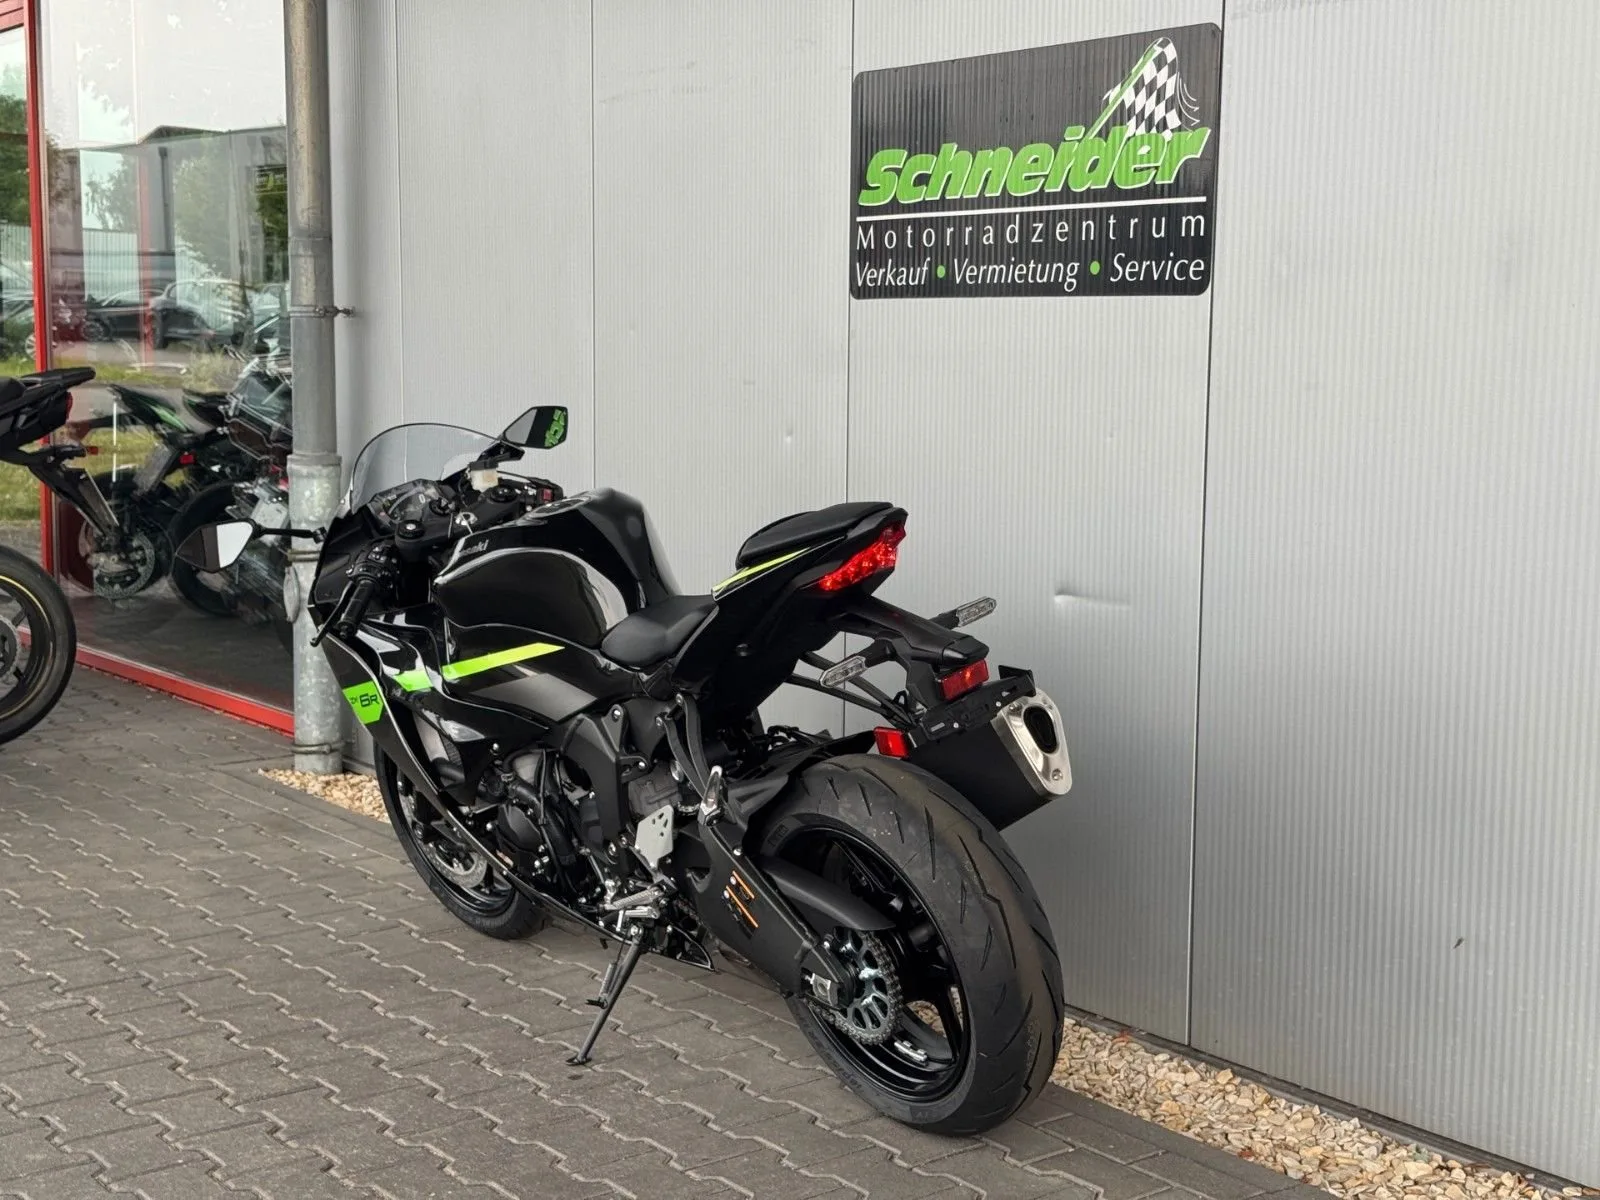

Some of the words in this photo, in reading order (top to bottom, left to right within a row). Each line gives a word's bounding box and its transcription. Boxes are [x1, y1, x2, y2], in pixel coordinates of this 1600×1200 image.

[856, 214, 1206, 250] Motorradzentrum
[856, 257, 931, 287] Verkauf
[953, 258, 1079, 292] Vermietung
[1109, 252, 1205, 282] Service
